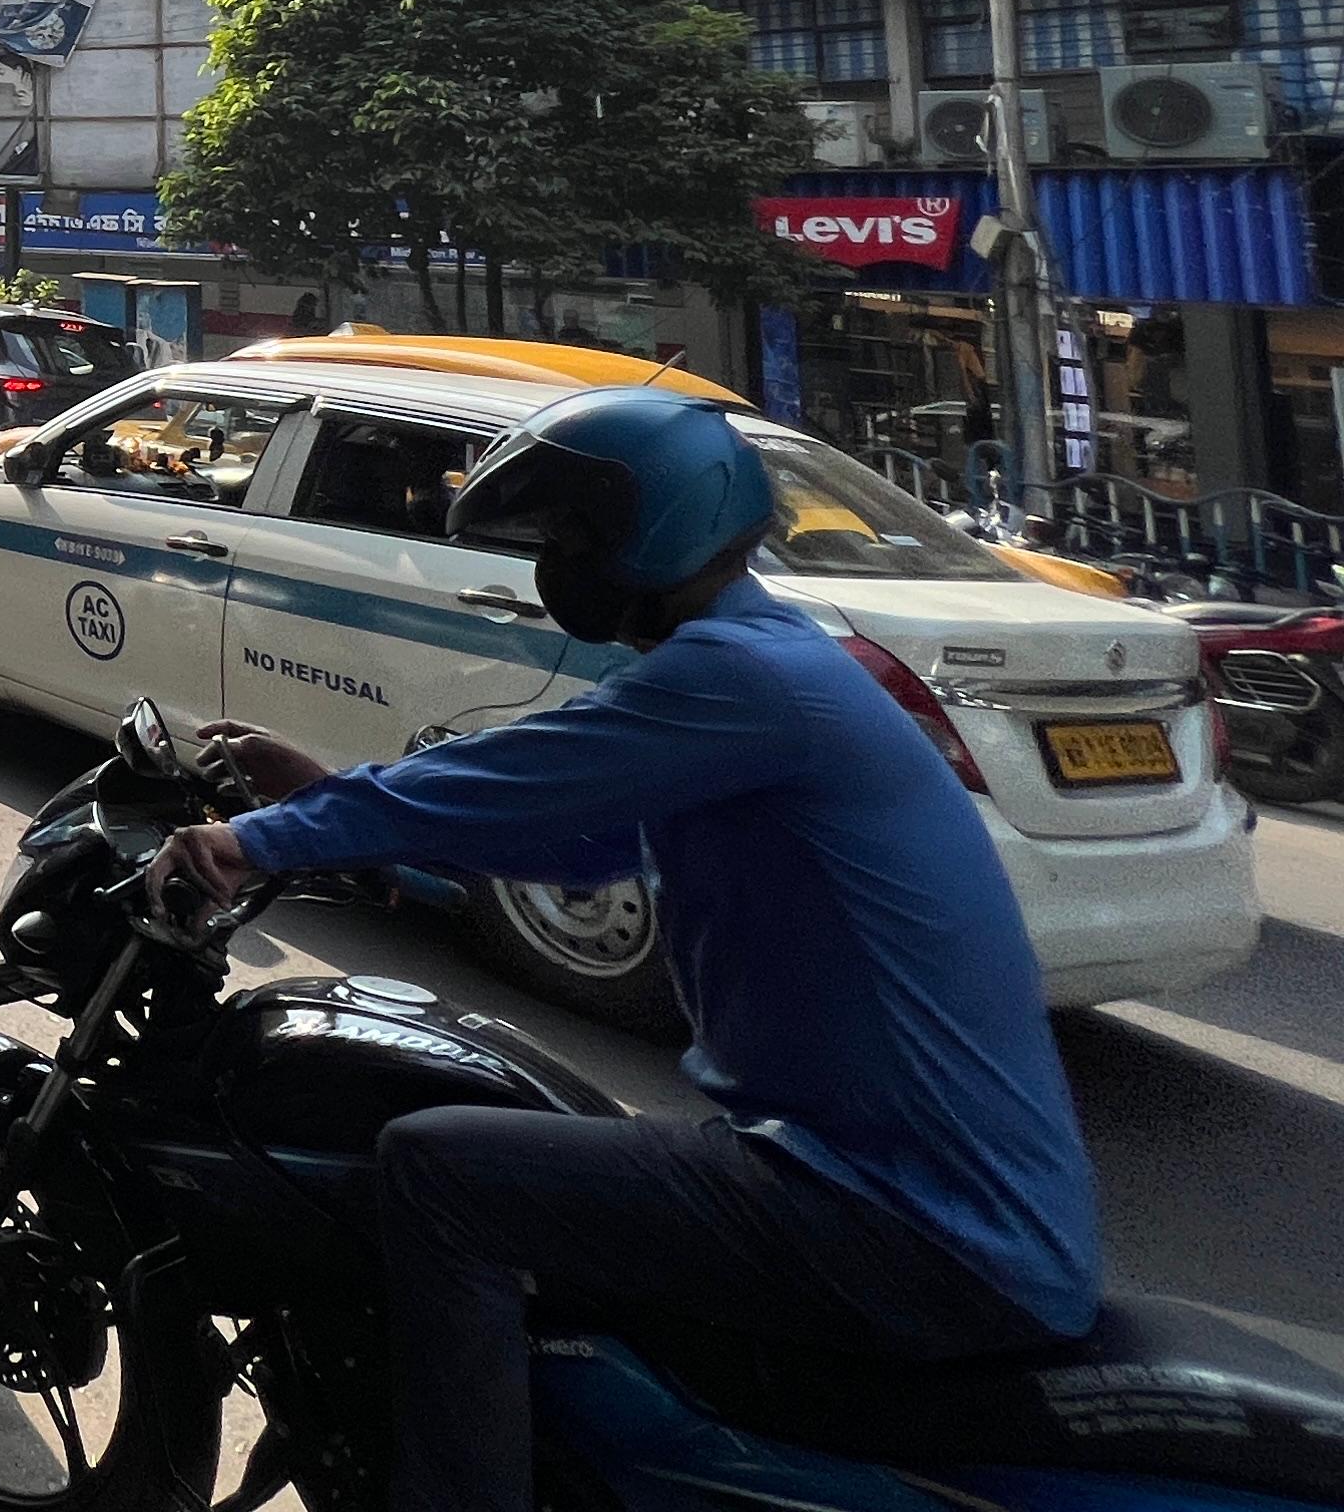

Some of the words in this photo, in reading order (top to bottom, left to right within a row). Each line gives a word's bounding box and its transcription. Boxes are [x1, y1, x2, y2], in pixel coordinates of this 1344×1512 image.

[82, 595, 110, 618] AC
[78, 616, 116, 643] TAXI
[243, 647, 276, 672] NO
[280, 658, 390, 706] REFUSAL
